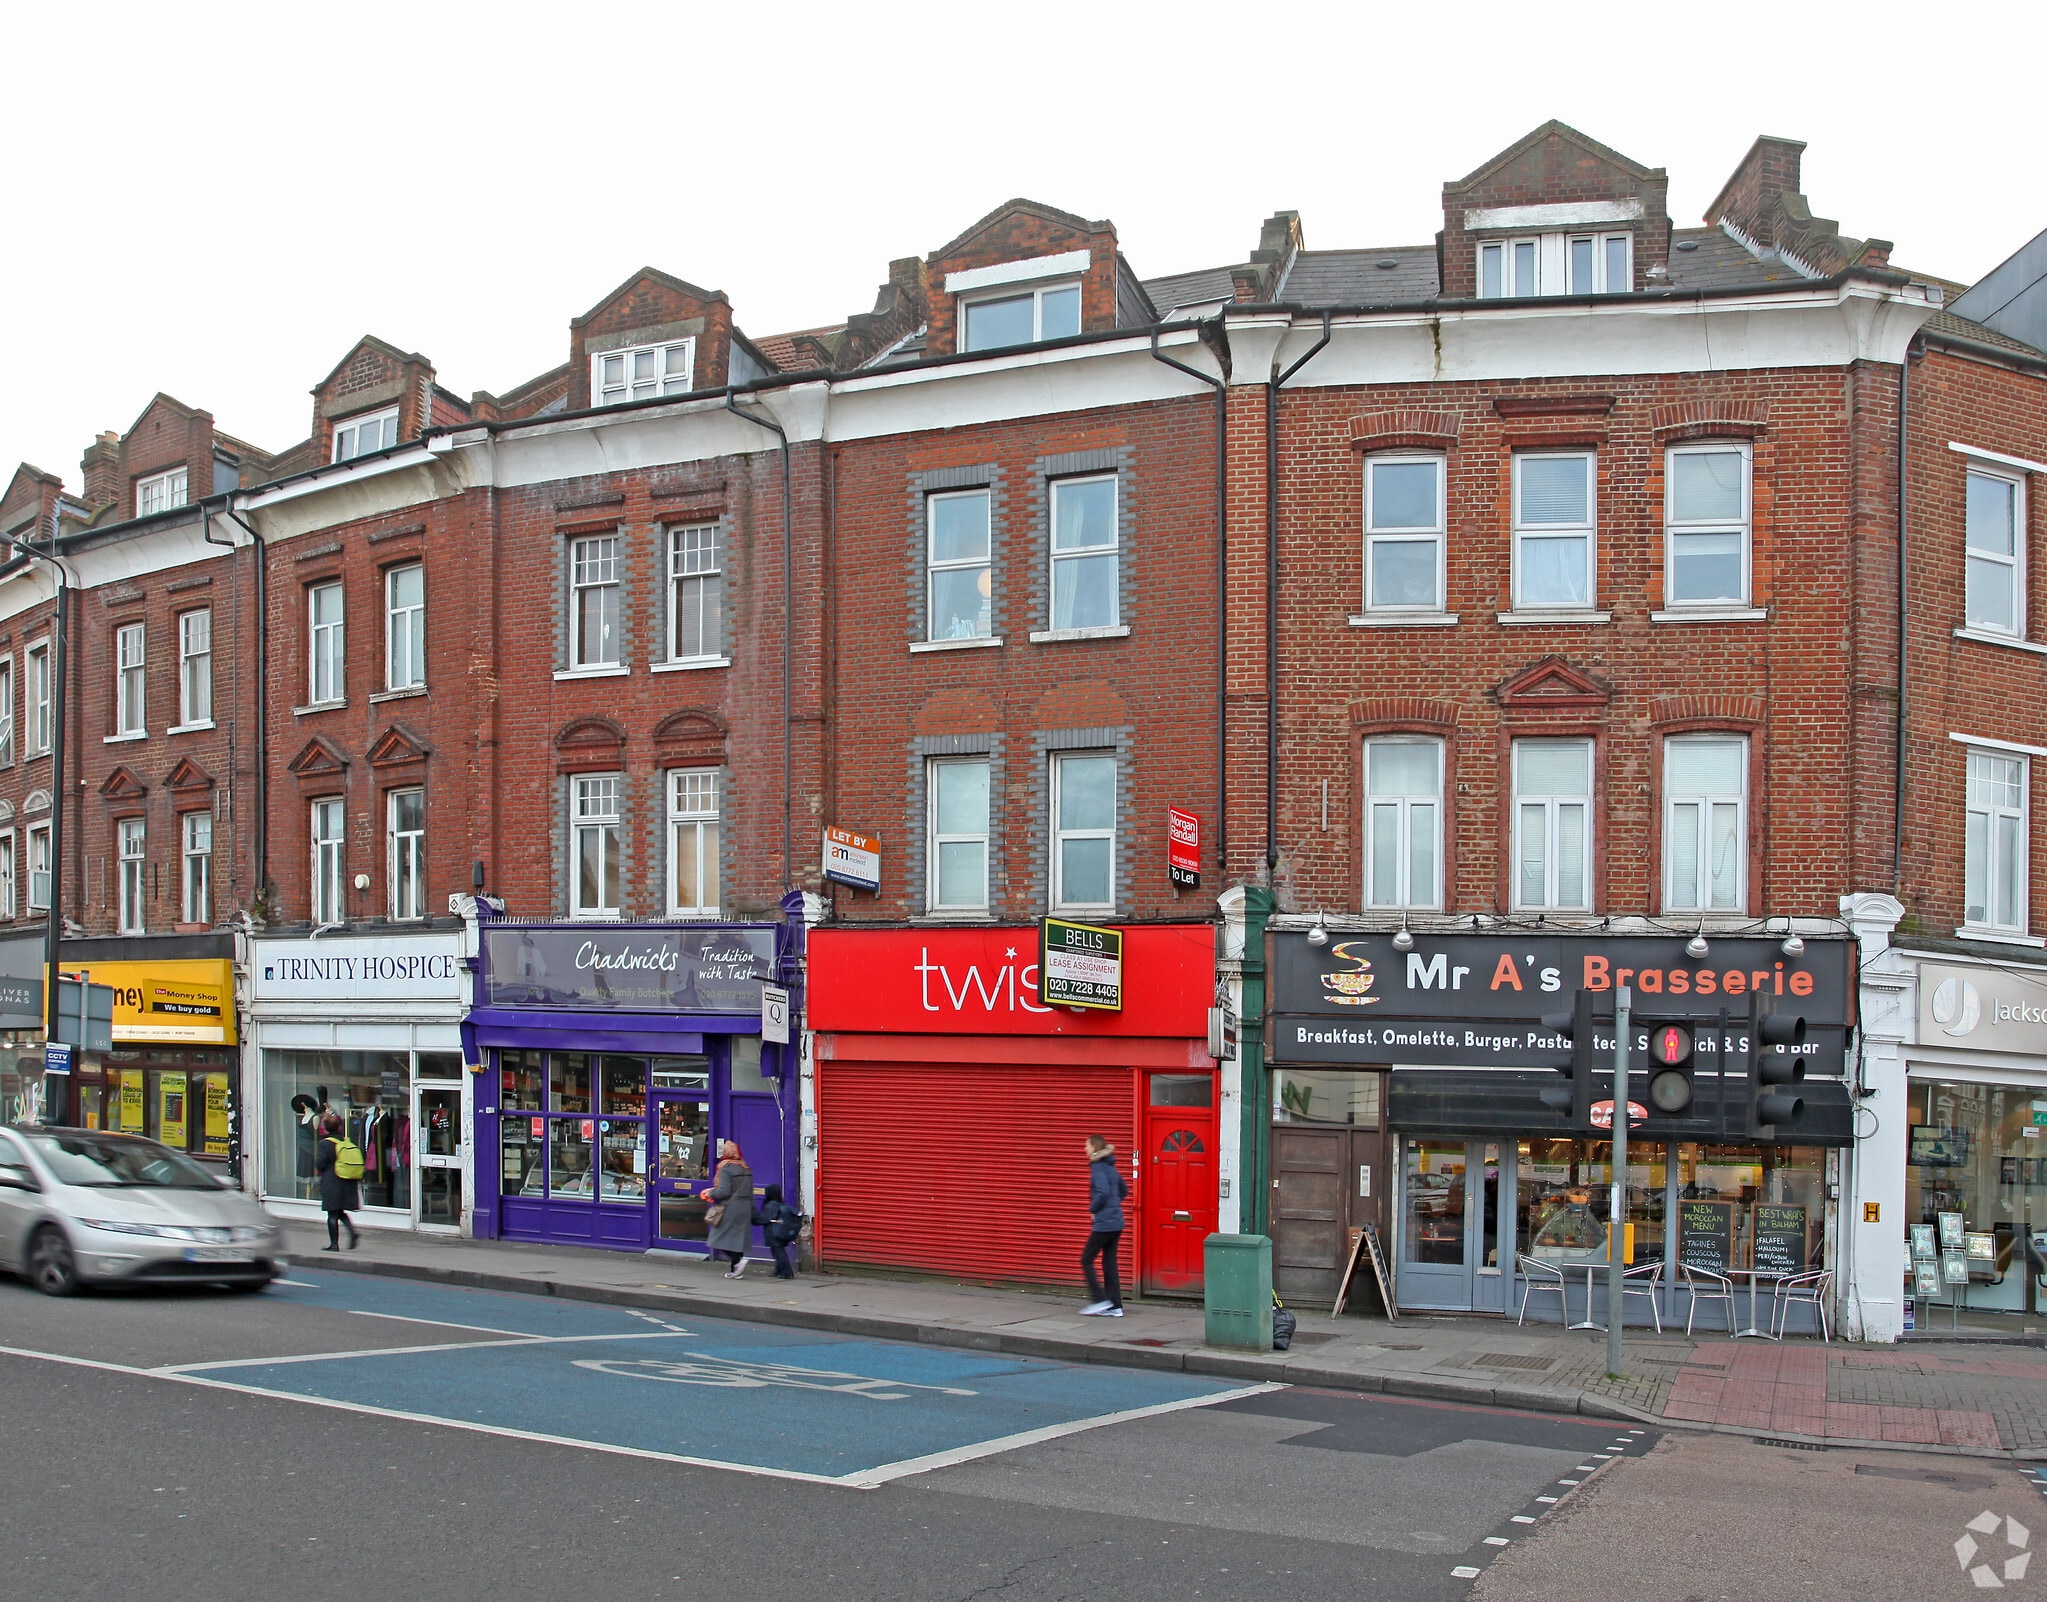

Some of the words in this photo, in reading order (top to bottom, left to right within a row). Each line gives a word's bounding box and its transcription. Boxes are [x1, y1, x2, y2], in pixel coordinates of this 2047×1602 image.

[1171, 813, 1196, 831] Morgan
[832, 830, 851, 843] LET
[853, 836, 867, 848] BY
[1171, 825, 1196, 843] Randall
[831, 846, 849, 861] am
[1171, 867, 1180, 880] To
[1181, 870, 1194, 885] Let
[1066, 929, 1103, 949] BELLS
[575, 940, 680, 971] Chadwicks
[701, 946, 755, 962] Tradition
[277, 957, 358, 980] TRINITY
[362, 955, 456, 980] HOSPICE
[699, 964, 723, 980] with
[1049, 957, 1072, 969] LEASE
[1073, 961, 1117, 975] ASSIGNMENT
[914, 946, 1086, 1014] twis
[1406, 953, 1470, 990] Mr
[1489, 954, 1562, 992] A's
[1583, 955, 1814, 996] Brasserie
[0, 987, 31, 998] IVER
[579, 986, 607, 1000] Quality
[610, 986, 635, 1000] Family
[637, 987, 675, 999] Butchers
[1049, 978, 1068, 992] 020
[1070, 980, 1094, 995] 7228
[1095, 984, 1118, 998] 4405
[112, 986, 144, 1014] ney
[166, 990, 195, 1001] Money
[197, 992, 218, 1002] Shop
[1049, 992, 1118, 1005] www.bellscommercial.co.uk
[164, 1004, 177, 1012] We
[178, 1004, 193, 1015] buy
[193, 1005, 212, 1016] gold
[770, 1003, 782, 1024] Q
[1297, 1027, 1377, 1046] Breakfast,
[1382, 1029, 1460, 1048] Omelette,
[1464, 1031, 1523, 1051] Burger,
[1527, 1031, 1574, 1050] Pasta
[1637, 1034, 1716, 1052] Sich
[47, 1052, 68, 1060] CCTV
[1591, 1103, 1639, 1124] CAÉ
[1692, 1204, 1713, 1214] NEW
[1758, 1207, 1781, 1219] BEST
[1781, 1209, 1805, 1222] WRAPS
[1684, 1213, 1723, 1223] MOROCCAN
[1758, 1220, 1767, 1228] IN
[1771, 1220, 1800, 1230] BALHAM
[1692, 1222, 1715, 1231] MENU
[1686, 1240, 1716, 1249] TAGINES
[1758, 1236, 1786, 1246] FALAFEL
[1686, 1248, 1721, 1259] COUSCOUS
[1758, 1245, 1788, 1254] HALLOUMI
[1686, 1258, 1723, 1268] MOROCCAN
